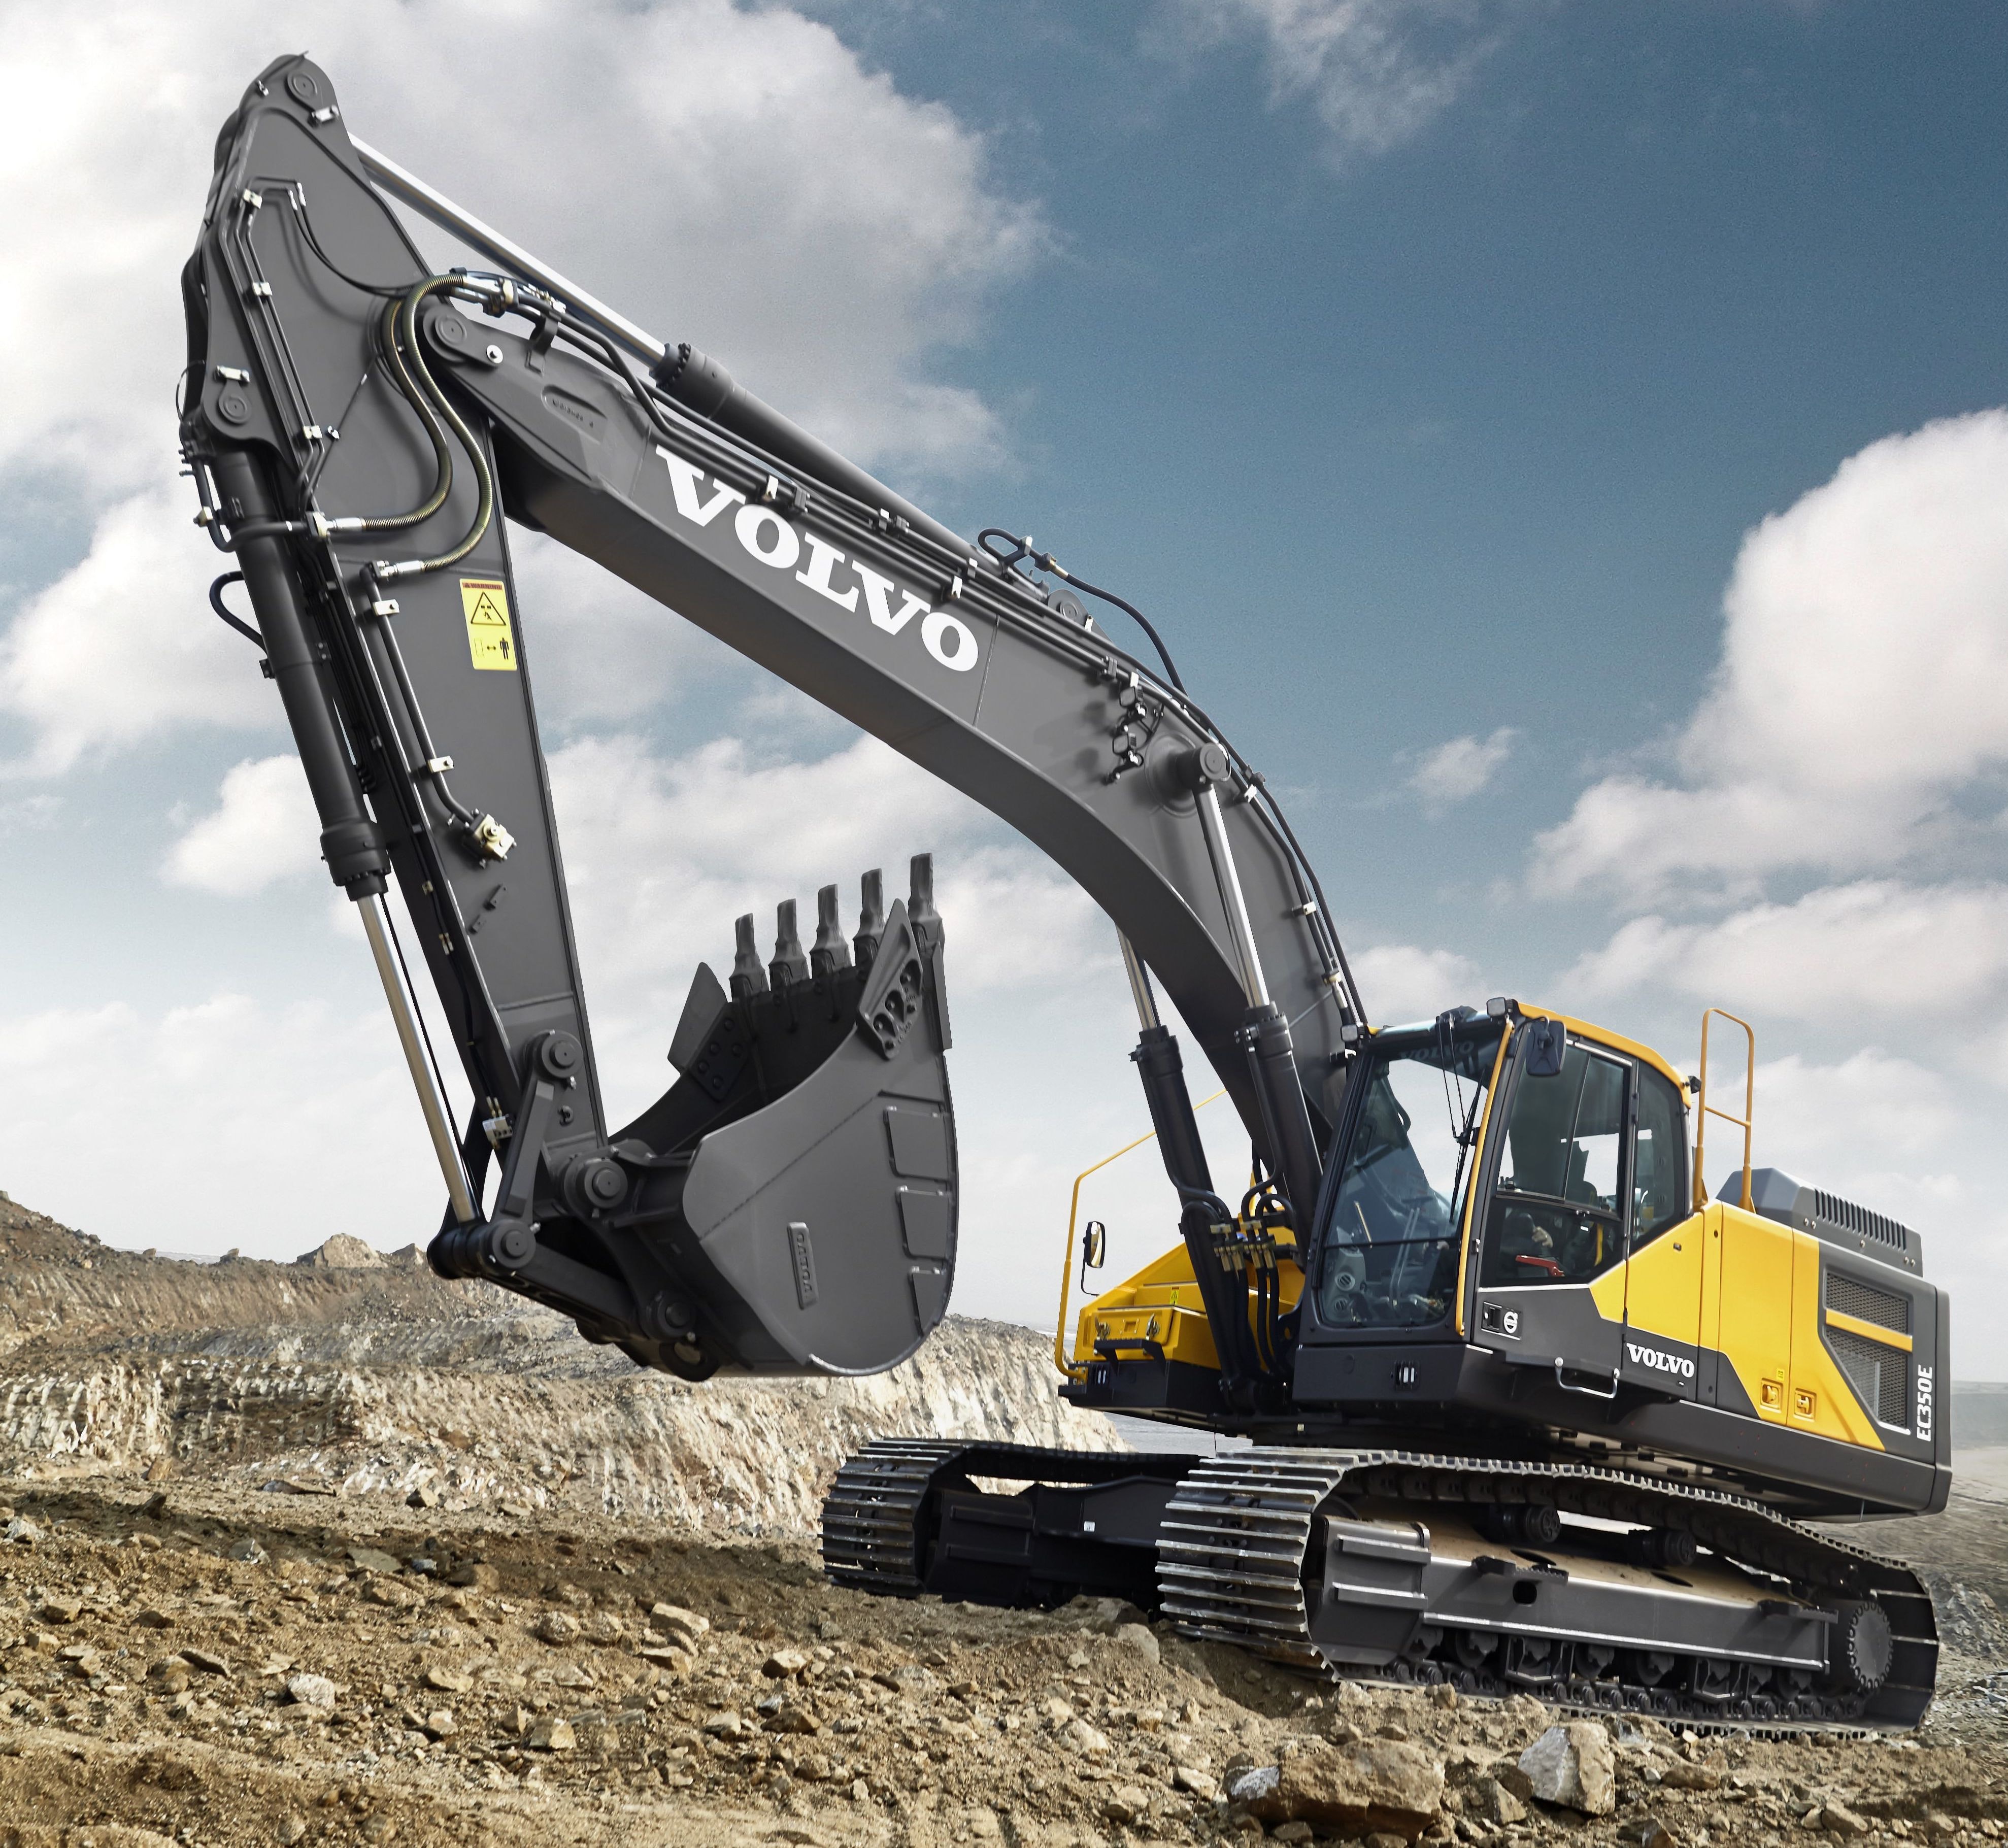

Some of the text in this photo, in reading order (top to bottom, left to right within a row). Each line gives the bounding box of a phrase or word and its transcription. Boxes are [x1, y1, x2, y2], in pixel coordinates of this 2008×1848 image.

[656, 445, 979, 671] VOLVO
[1398, 1041, 1475, 1060] VOLVO
[797, 1232, 812, 1293] VOLVO
[1626, 1342, 1695, 1378] VOLVO
[1917, 1364, 1932, 1441] EC350E
